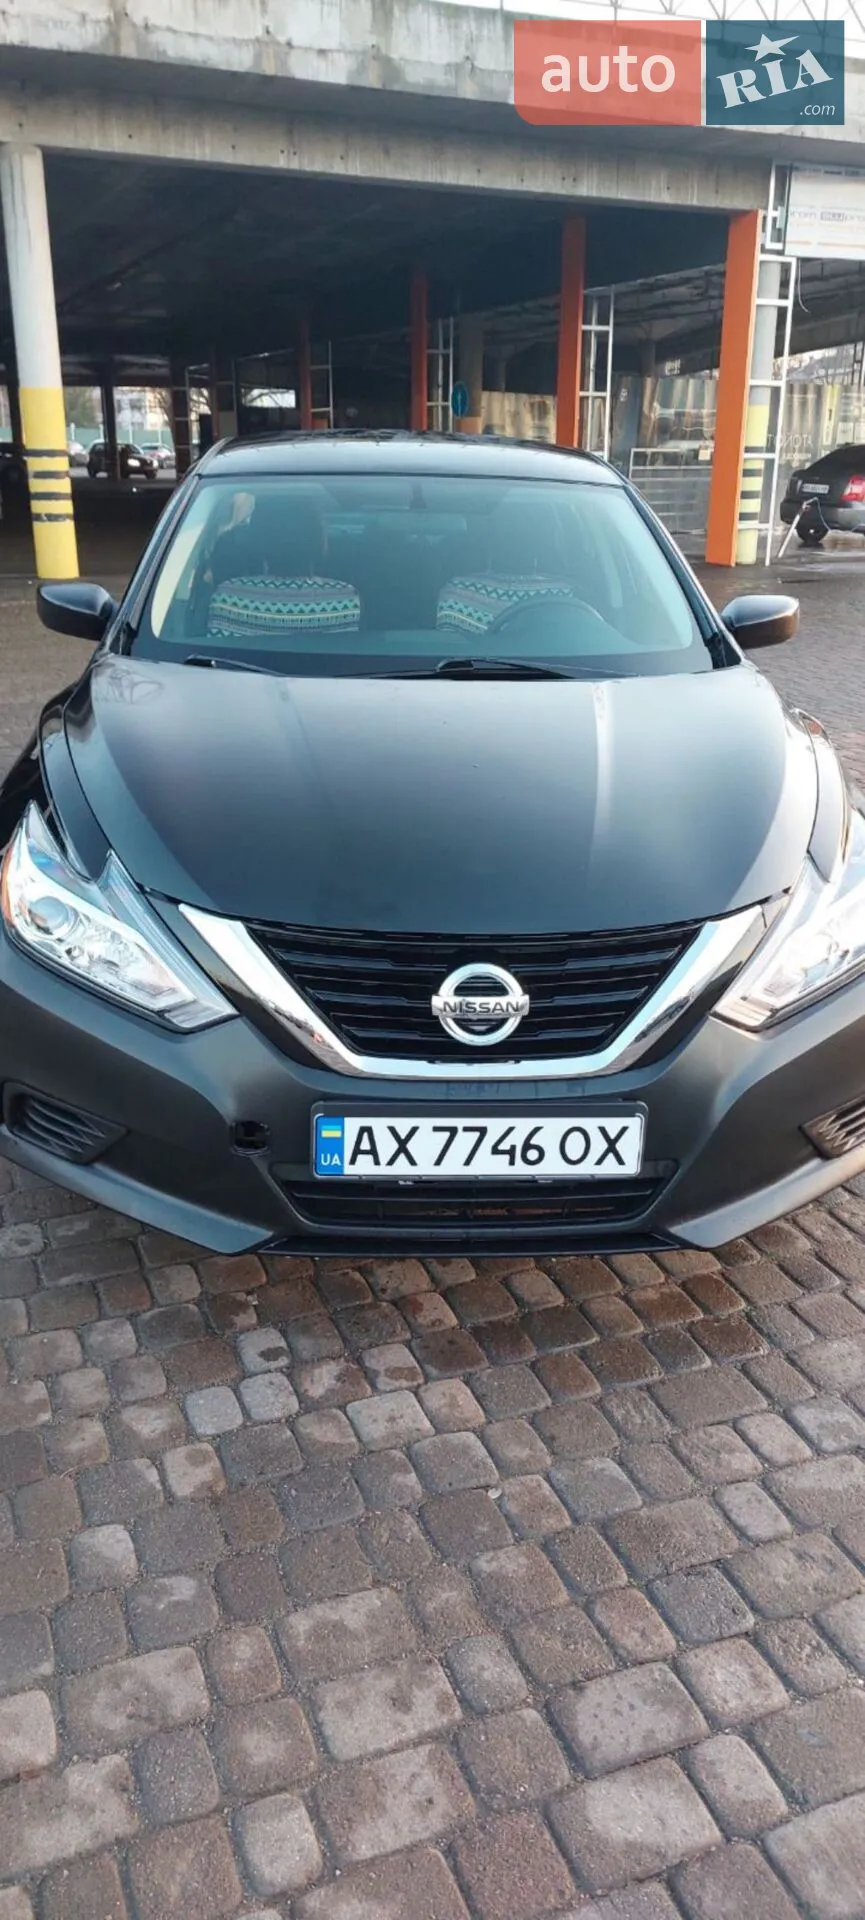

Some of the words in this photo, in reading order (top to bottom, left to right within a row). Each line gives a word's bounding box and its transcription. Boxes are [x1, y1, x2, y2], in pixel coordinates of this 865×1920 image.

[443, 1001, 519, 1013] NISSAN
[349, 1126, 420, 1166] AX
[432, 1126, 545, 1167] 7746
[559, 1126, 629, 1166] OX
[321, 1153, 342, 1166] UA
